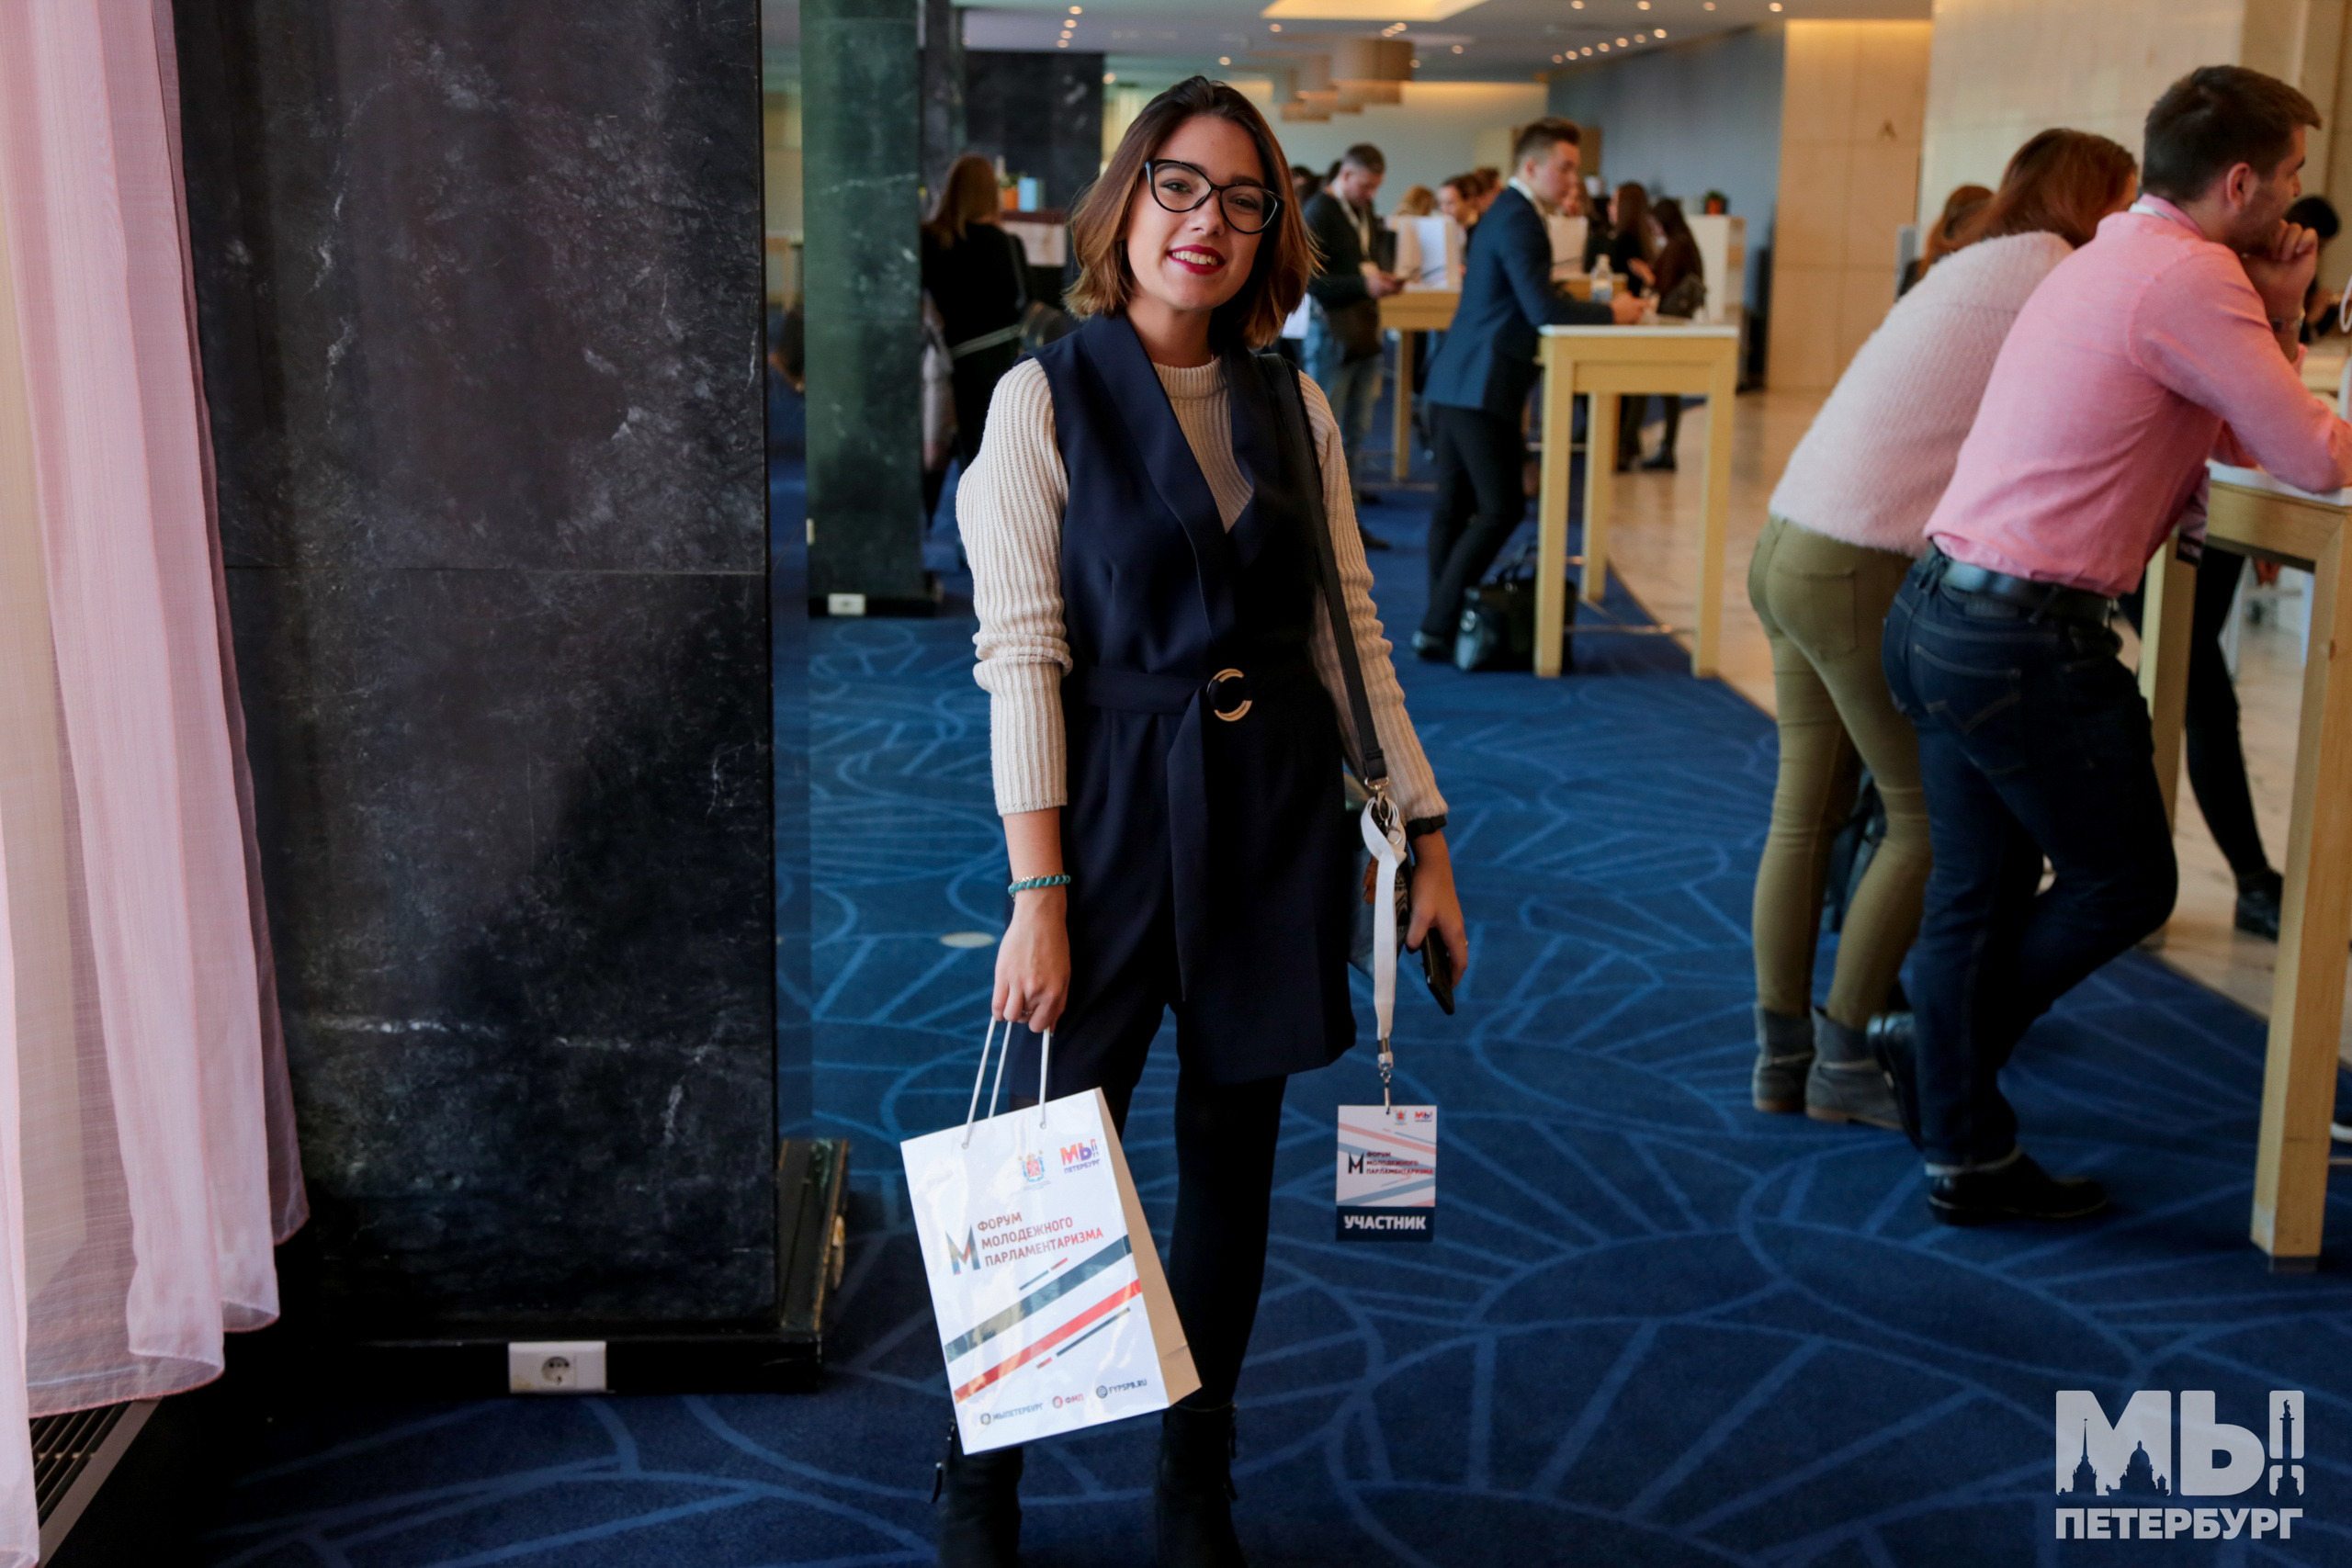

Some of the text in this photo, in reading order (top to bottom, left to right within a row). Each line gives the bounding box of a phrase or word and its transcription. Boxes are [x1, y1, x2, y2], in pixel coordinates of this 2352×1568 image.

[1064, 1159, 1101, 1174] ПЕТЕРБУРГ
[978, 1212, 1023, 1232] ФОРУМ
[1344, 1215, 1426, 1230] УЧАСТНИК
[981, 1216, 1074, 1249] МОЛОДЕЖНОГО
[985, 1227, 1104, 1267] ПАРЛАМЕНТАРИЗМА
